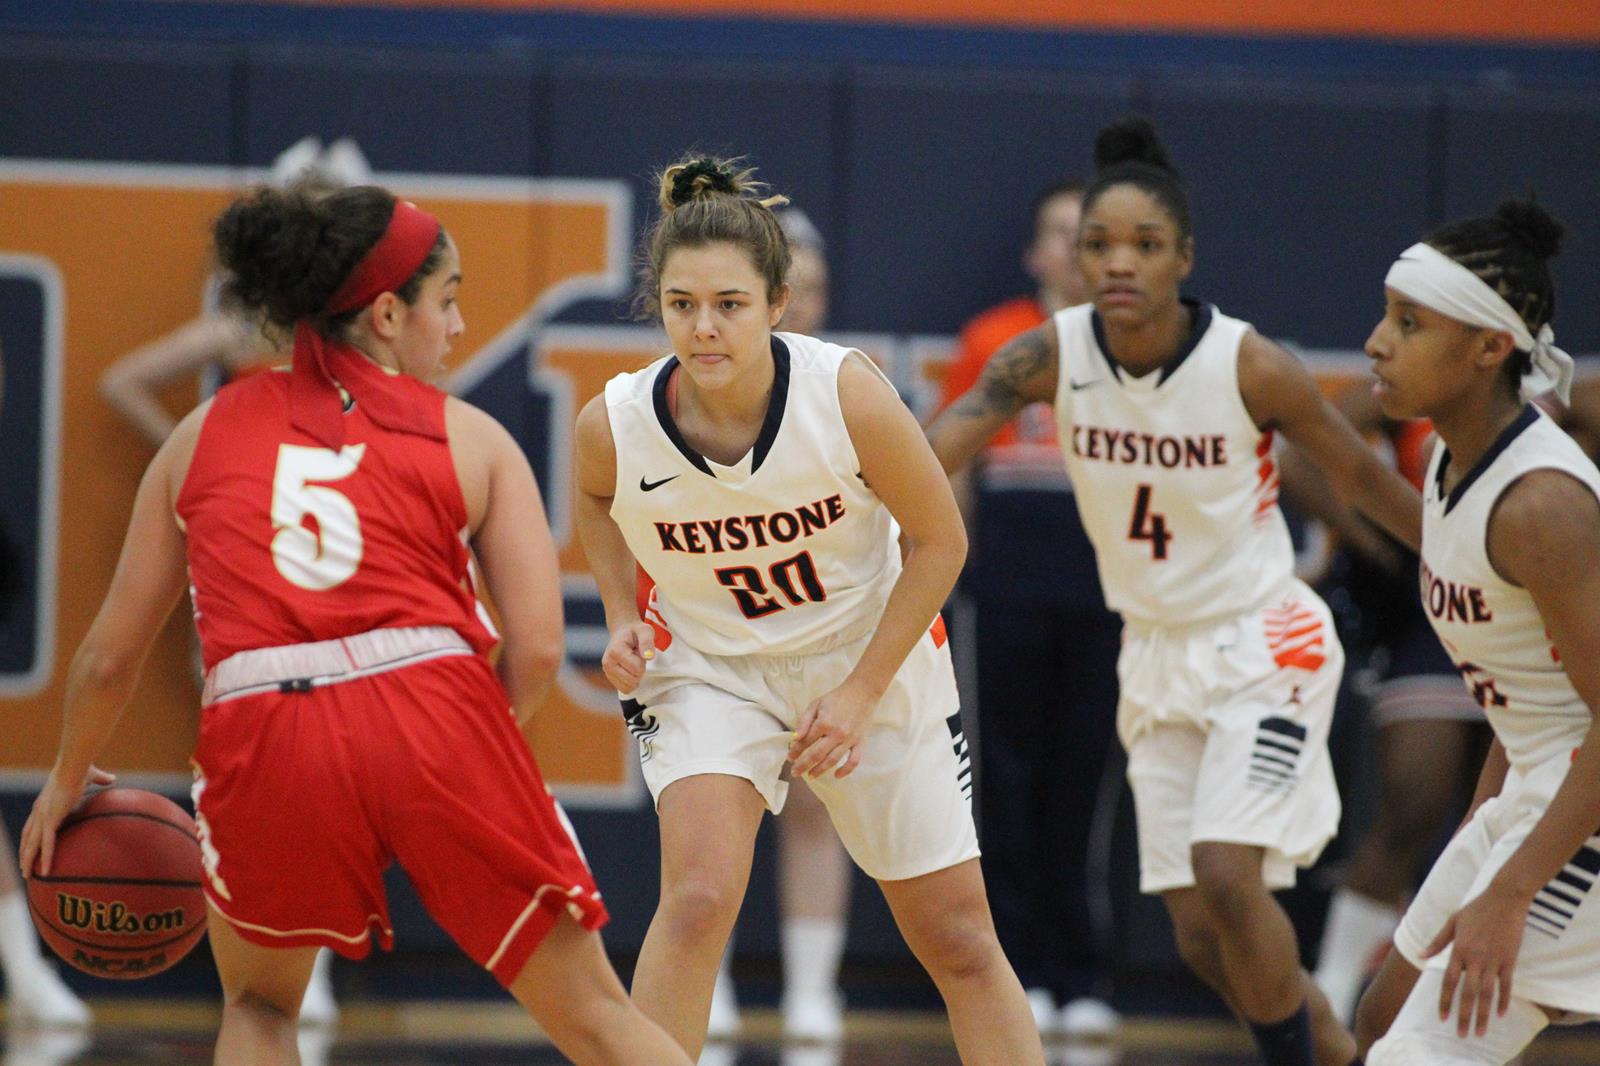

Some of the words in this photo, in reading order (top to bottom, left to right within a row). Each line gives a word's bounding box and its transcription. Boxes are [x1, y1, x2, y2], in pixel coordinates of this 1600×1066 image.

[270, 442, 367, 592] 5
[653, 494, 846, 554] KEYSTONE
[1127, 484, 1173, 561] 4
[713, 550, 827, 619] 20
[56, 893, 185, 935] Wilson
